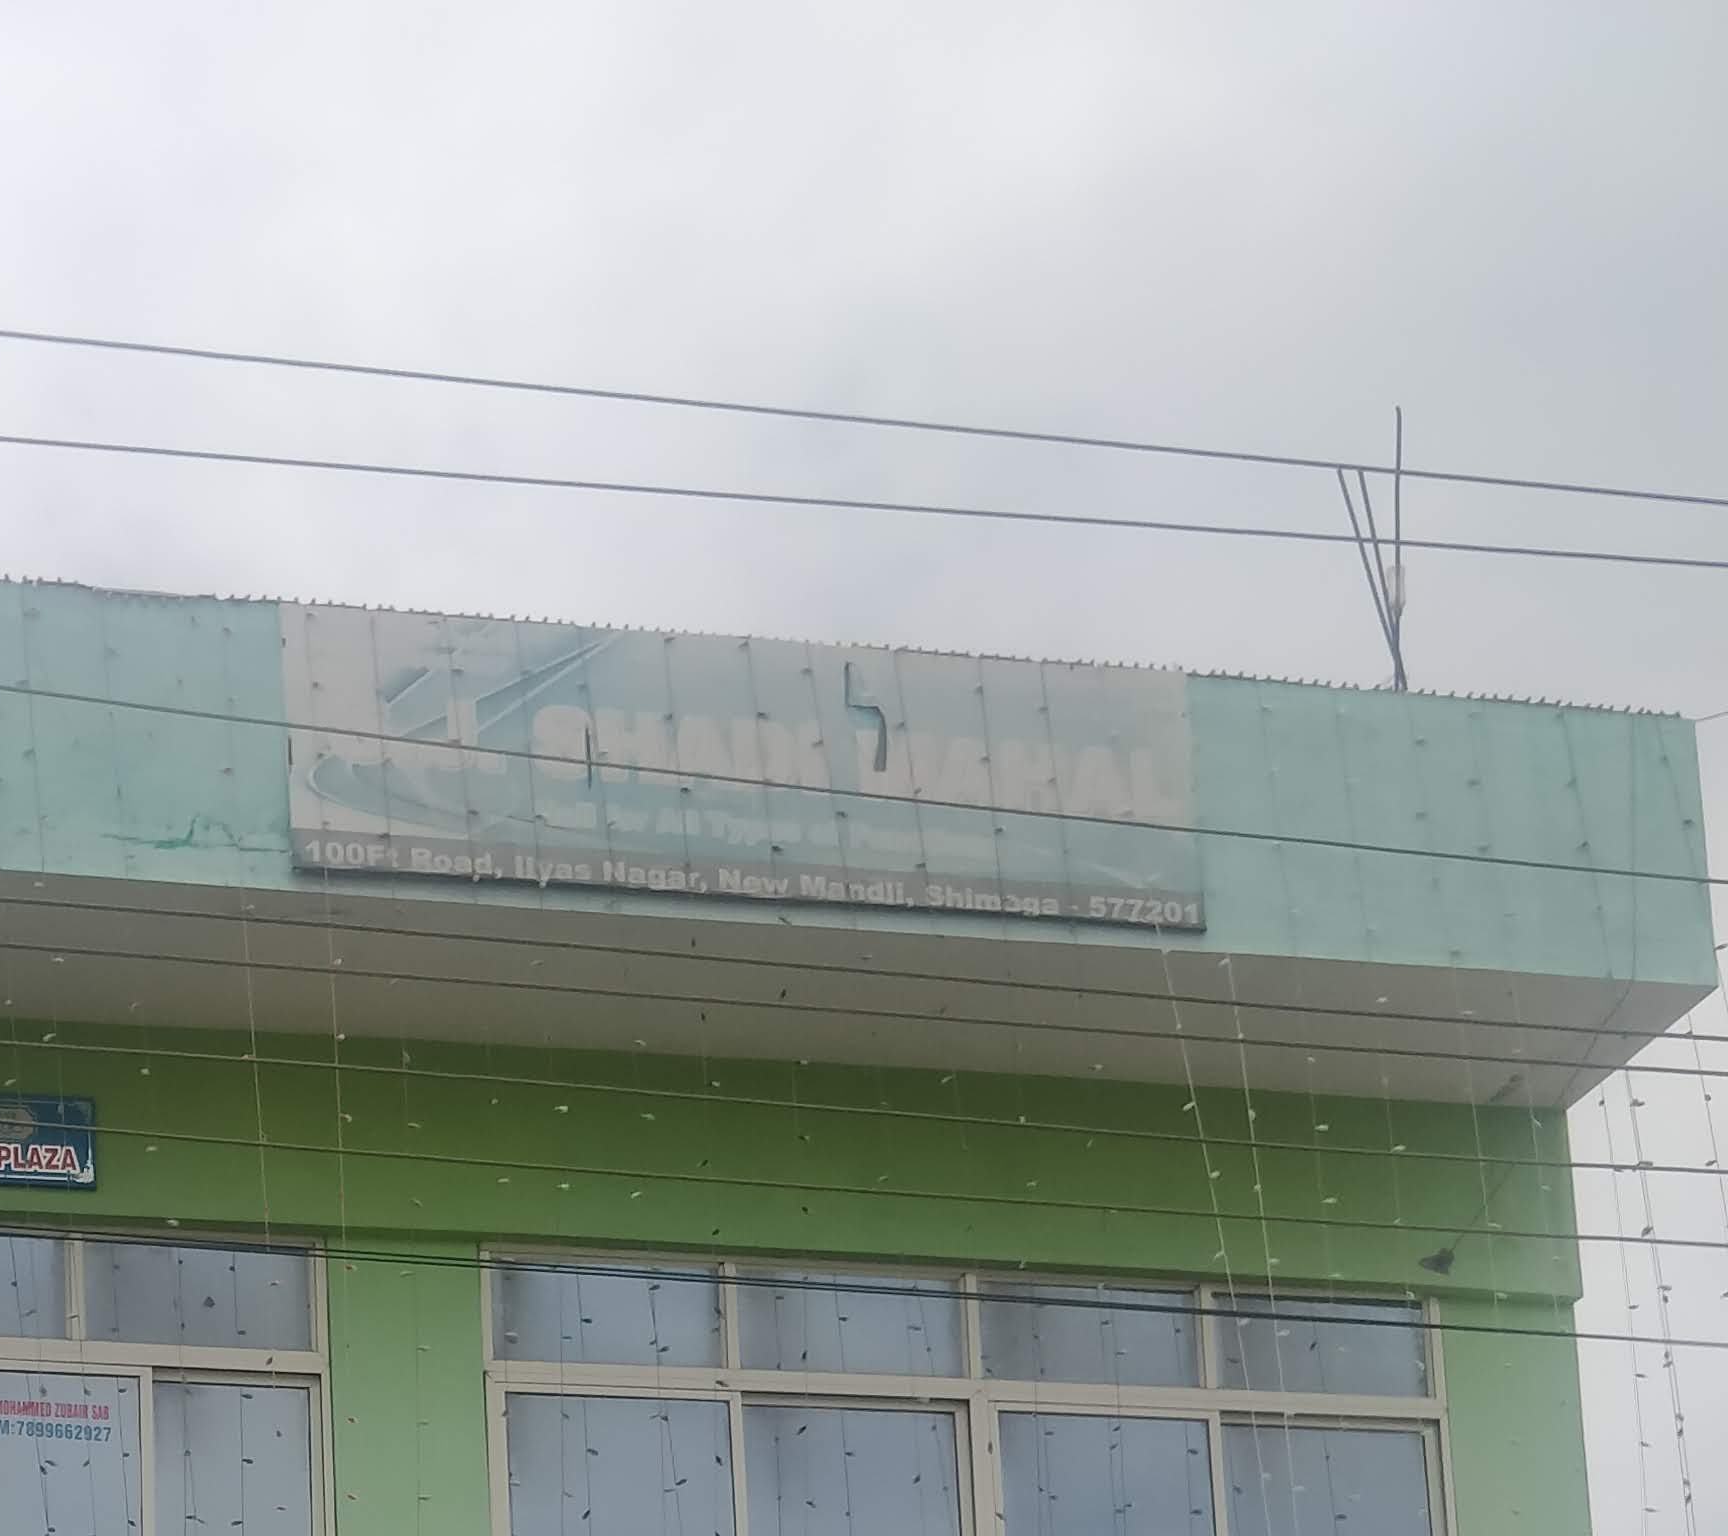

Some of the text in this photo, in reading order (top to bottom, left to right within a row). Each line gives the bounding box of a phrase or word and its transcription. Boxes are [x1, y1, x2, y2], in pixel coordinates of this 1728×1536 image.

[410, 847, 502, 880] Road,
[602, 859, 708, 893] Nagar,
[718, 866, 791, 897] New
[1088, 895, 1201, 925] 577201
